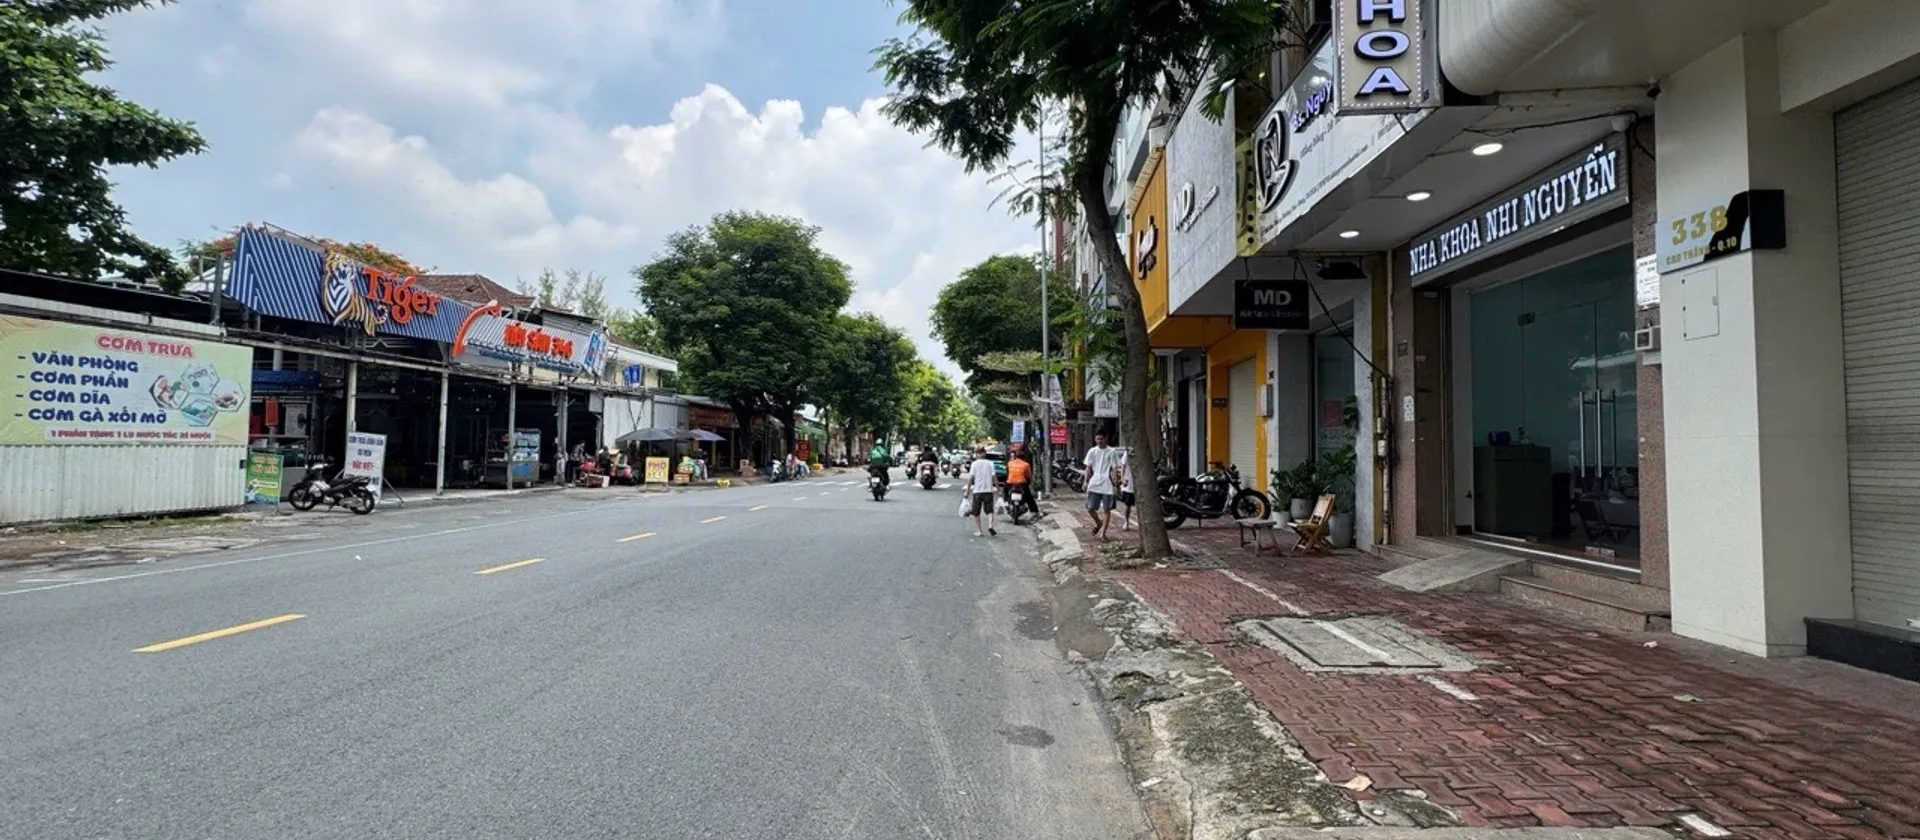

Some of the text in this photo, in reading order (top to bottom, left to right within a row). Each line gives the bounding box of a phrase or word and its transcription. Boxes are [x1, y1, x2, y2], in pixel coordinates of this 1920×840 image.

[1410, 143, 1616, 276] NHA KHOA NHI NGUYỄN
[1672, 205, 1728, 245] 338
[1717, 236, 1738, 251] Q.10
[363, 266, 441, 324] Tiger
[1253, 289, 1292, 305] MD
[97, 334, 193, 358] CƠM TRƯA
[32, 350, 139, 372] VĂN PHÒNG
[30, 370, 129, 388] CƠM PHẦN
[29, 389, 110, 405] CƠM DĨA
[28, 408, 74, 422] CƠM
[79, 408, 105, 423] GÀ
[107, 406, 136, 423] XỐI
